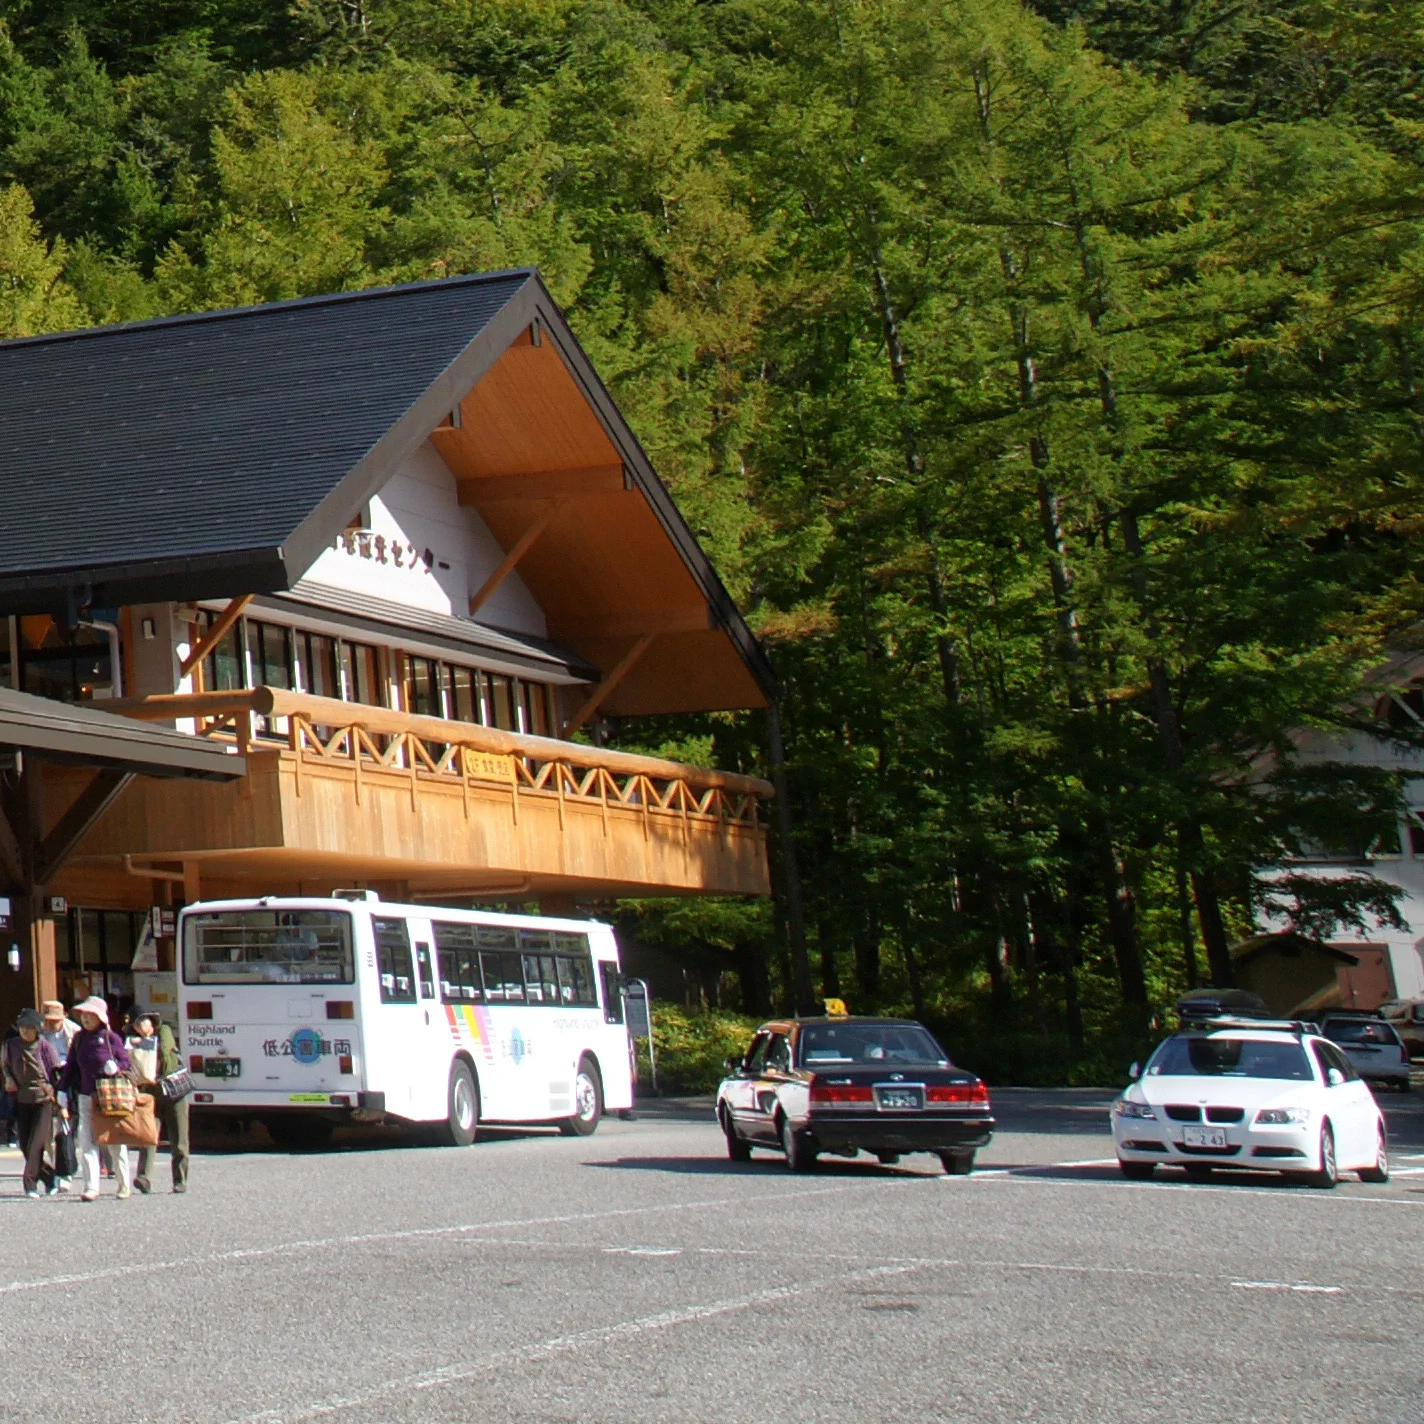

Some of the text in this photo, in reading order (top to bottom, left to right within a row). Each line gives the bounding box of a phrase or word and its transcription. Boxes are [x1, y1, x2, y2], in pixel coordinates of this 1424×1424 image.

[188, 1025, 236, 1037] Highland
[188, 1036, 224, 1047] Shuttle
[262, 1038, 351, 1057] 低公害車両
